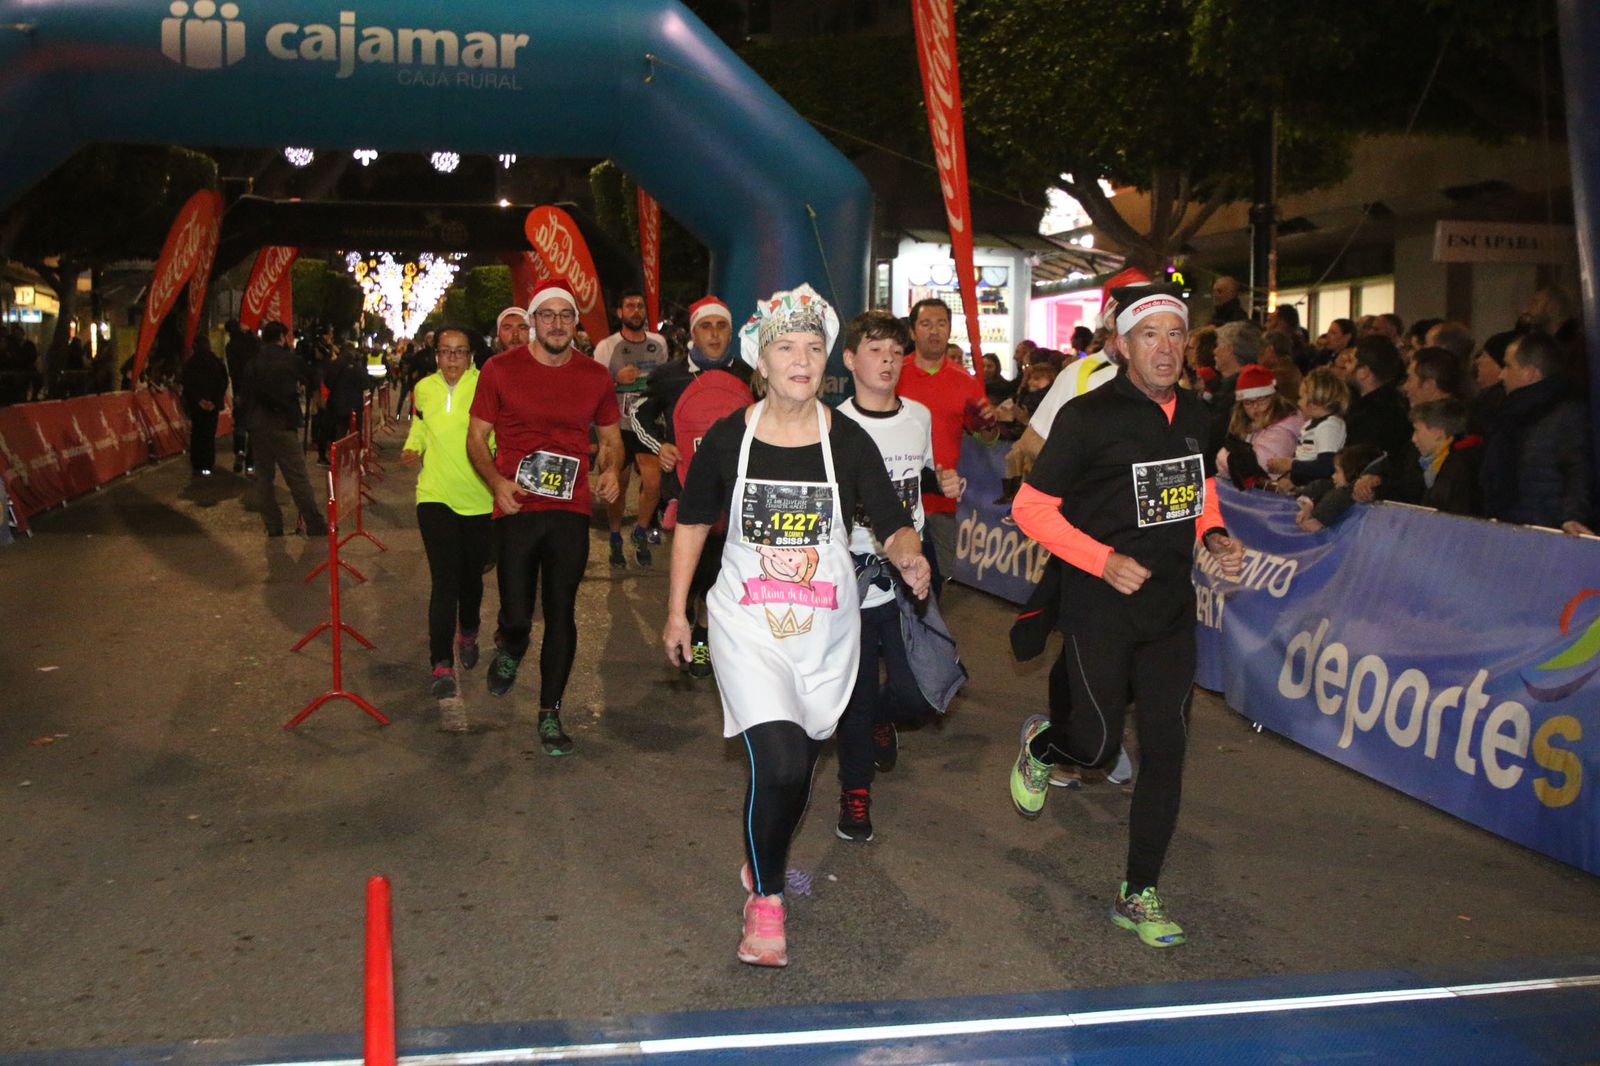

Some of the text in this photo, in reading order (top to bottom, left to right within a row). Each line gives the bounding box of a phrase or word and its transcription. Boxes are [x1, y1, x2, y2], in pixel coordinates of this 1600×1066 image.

[265, 11, 530, 79] cajamar
[398, 68, 524, 91] CAJA RURAL
[541, 471, 562, 487] 712
[1160, 485, 1195, 506] 1235
[771, 512, 819, 531] 1227
[956, 508, 1052, 585] deporte
[1277, 617, 1583, 809] deportes
